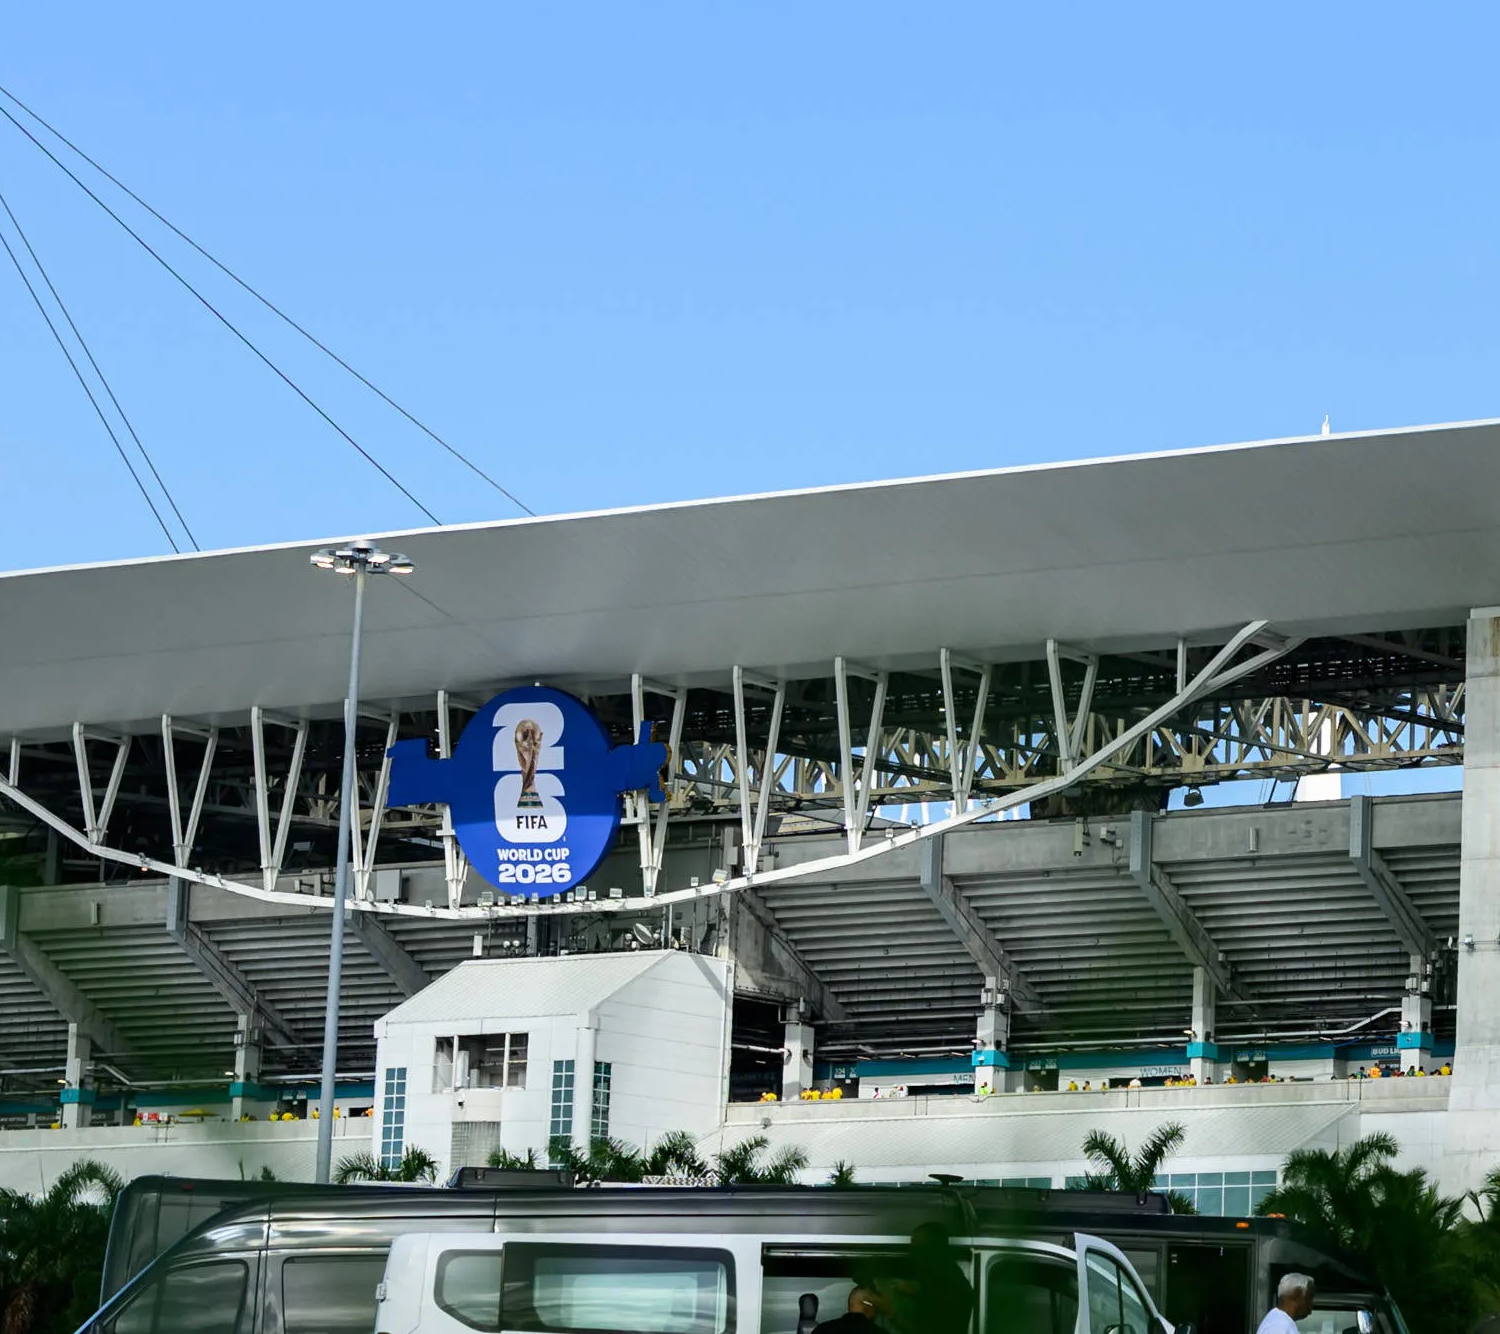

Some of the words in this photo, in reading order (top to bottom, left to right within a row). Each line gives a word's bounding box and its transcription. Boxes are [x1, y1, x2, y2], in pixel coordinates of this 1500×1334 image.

[516, 815, 548, 829] FIFA
[497, 848, 542, 861] WORLD
[544, 848, 570, 861] CUP
[498, 862, 571, 884] 2026
[1140, 1066, 1182, 1077] WOMEN
